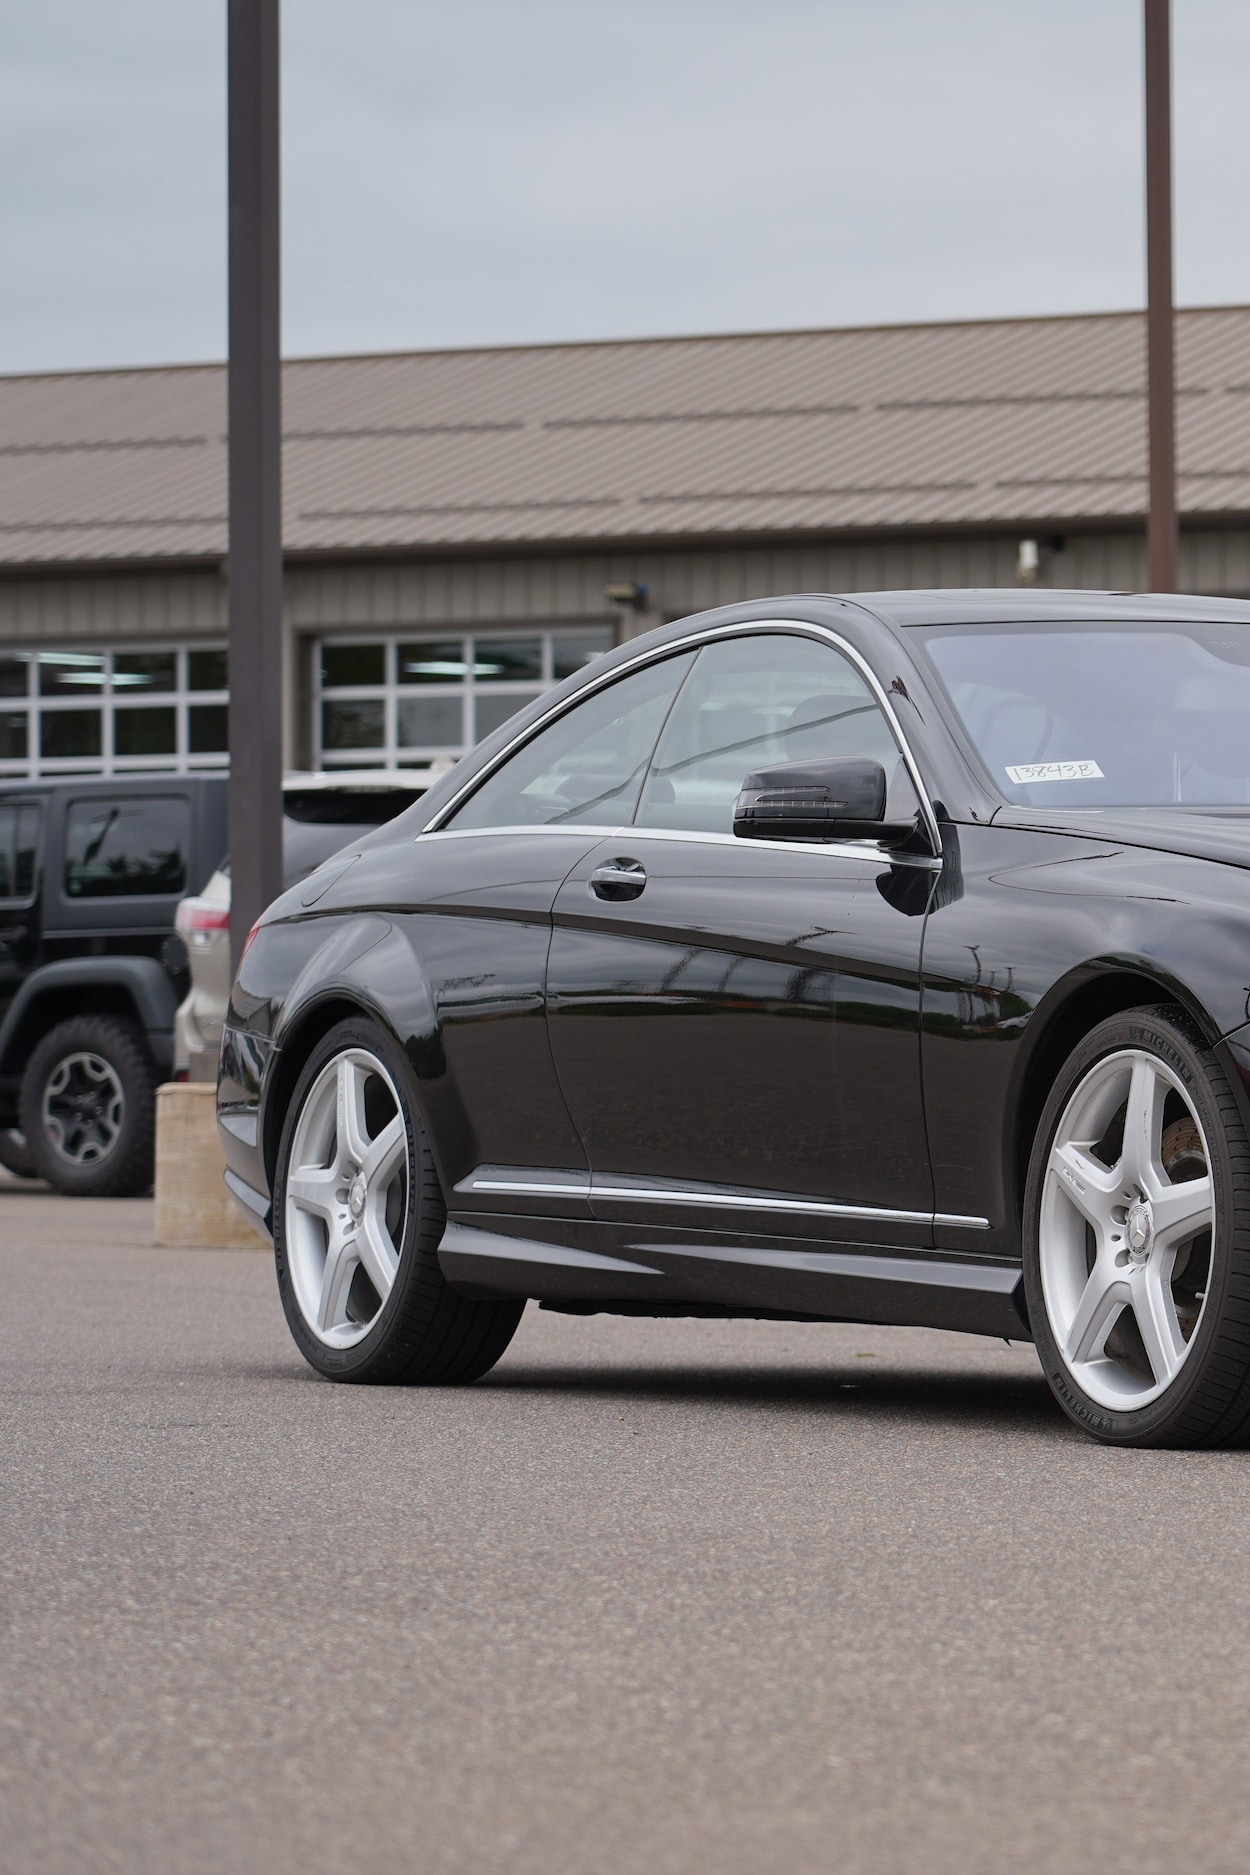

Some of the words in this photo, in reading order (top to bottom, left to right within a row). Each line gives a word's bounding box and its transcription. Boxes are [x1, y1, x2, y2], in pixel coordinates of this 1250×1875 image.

[1013, 763, 1094, 782] 13843B
[1142, 1030, 1193, 1081] MICHELIN
[1054, 1376, 1102, 1429] MICHELIN
